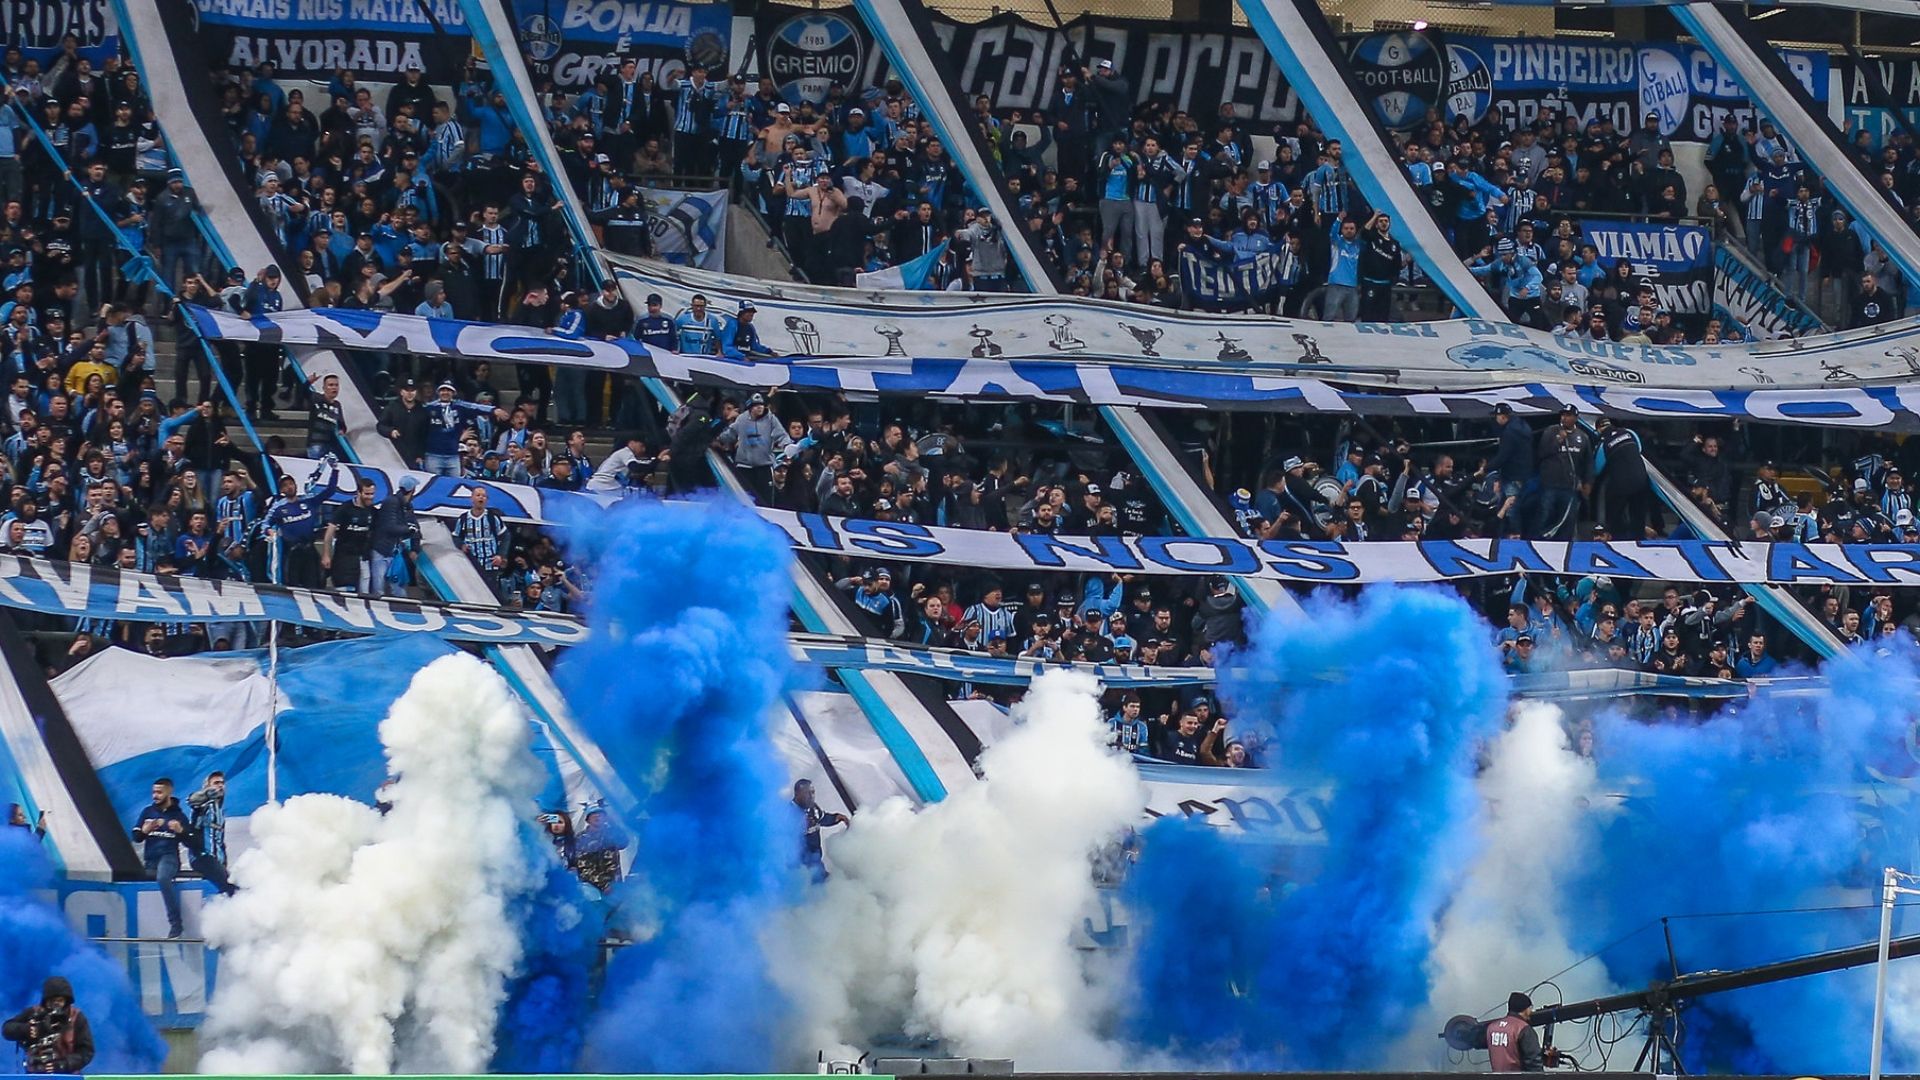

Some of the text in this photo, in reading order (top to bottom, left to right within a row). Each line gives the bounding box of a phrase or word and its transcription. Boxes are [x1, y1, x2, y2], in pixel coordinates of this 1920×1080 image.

[0, 0, 105, 48] RDAS
[562, 0, 692, 36] BONJA
[229, 36, 426, 73] ALVORADA
[773, 52, 855, 75] GRÊMIO
[1493, 44, 1633, 85] PINHEIRO
[1590, 226, 1704, 262] VIAMÃO
[1012, 534, 1362, 581] NOS
[1491, 1031, 1508, 1047] 1914
